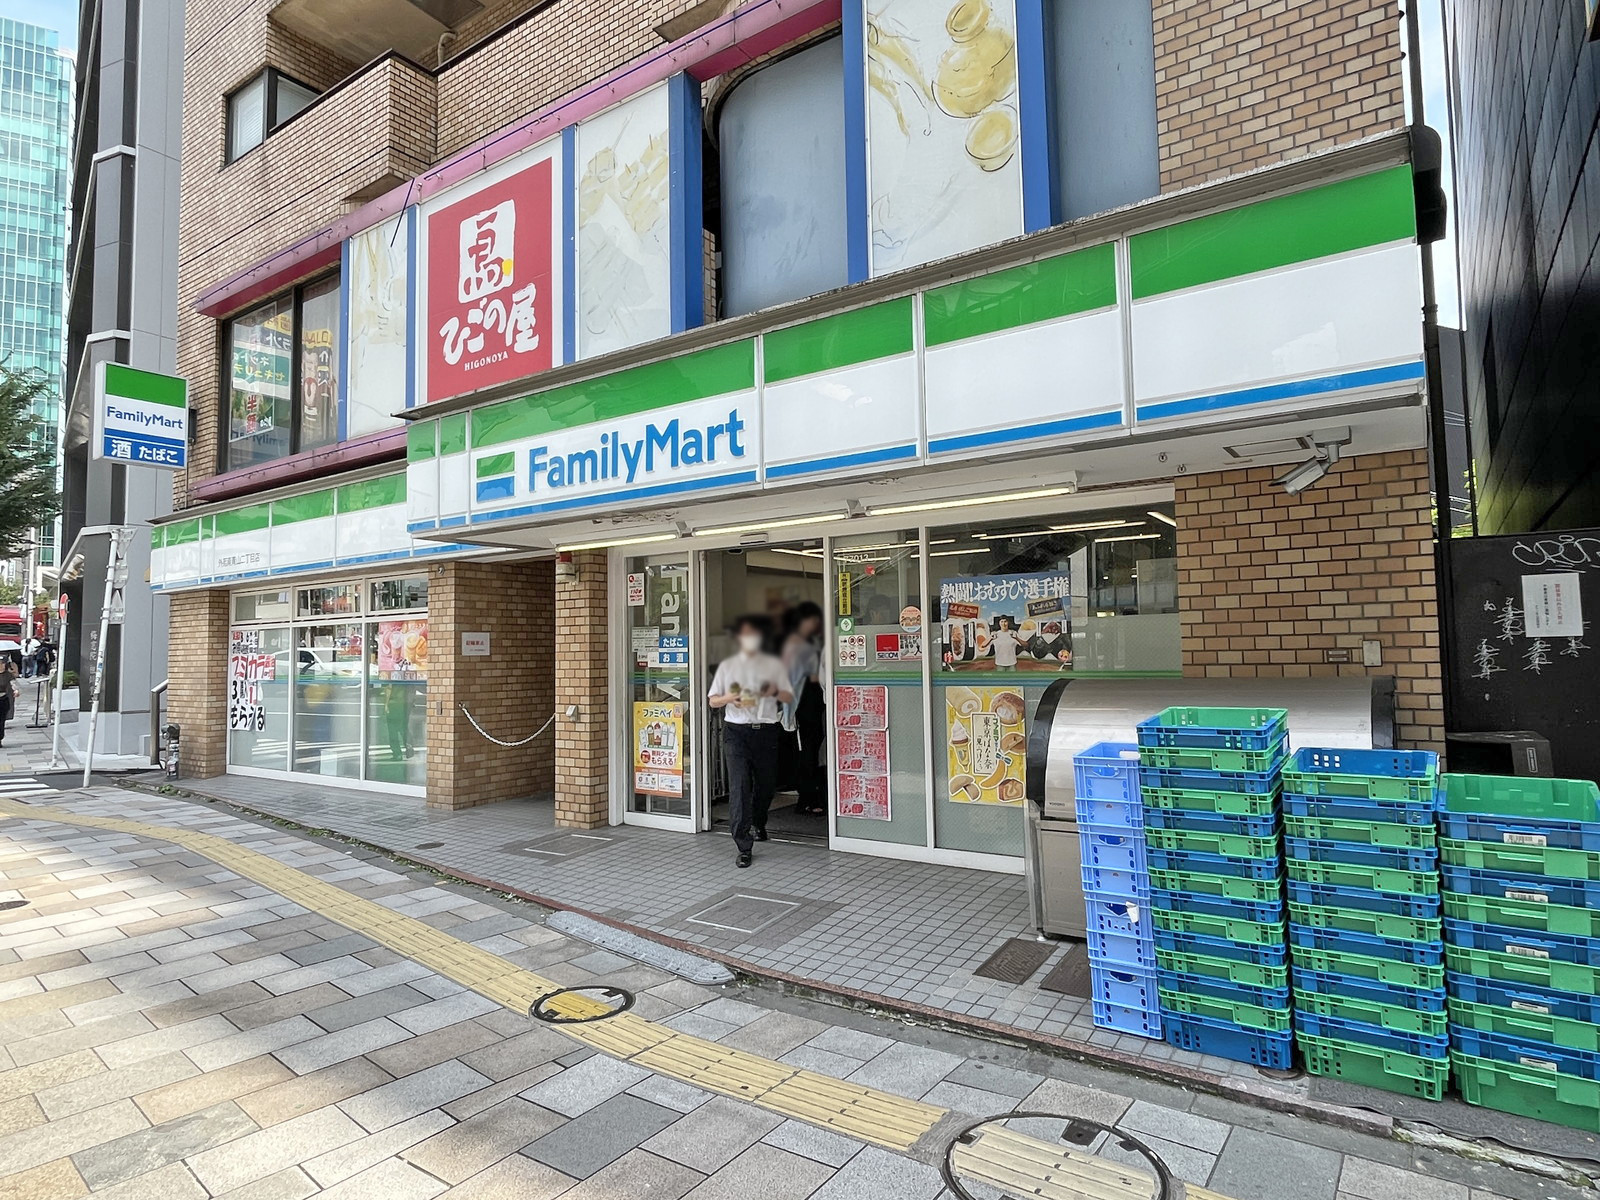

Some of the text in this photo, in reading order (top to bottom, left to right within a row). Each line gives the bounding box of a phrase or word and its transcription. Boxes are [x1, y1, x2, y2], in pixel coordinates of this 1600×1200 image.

[440, 283, 539, 365] ひごの屋
[464, 350, 509, 371] HIGONOYA
[107, 406, 183, 429] FamilyMart
[111, 439, 178, 463] 酒 たばこ
[529, 408, 745, 492] FamilyMart
[941, 576, 1070, 603] 熱闘!おむすび選手権
[662, 638, 683, 648] たばこ
[643, 709, 672, 718] ファミペイ
